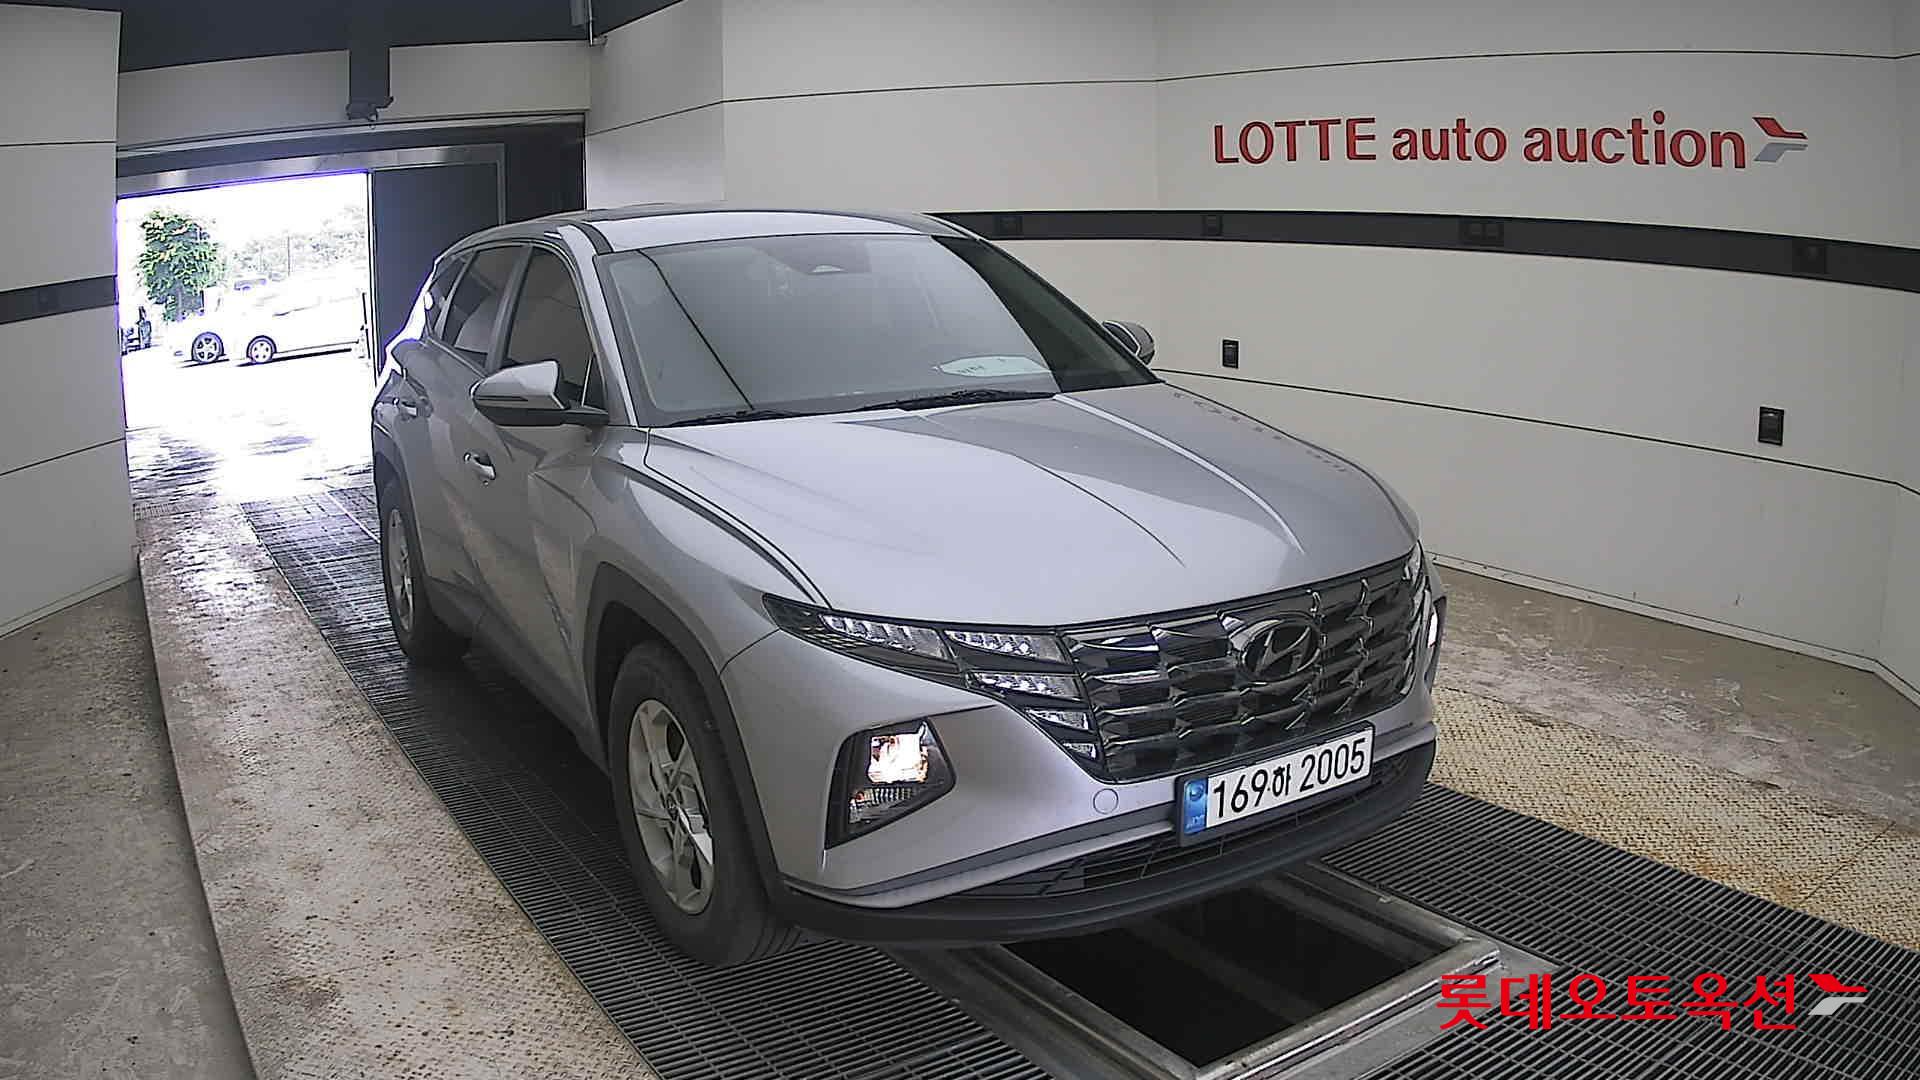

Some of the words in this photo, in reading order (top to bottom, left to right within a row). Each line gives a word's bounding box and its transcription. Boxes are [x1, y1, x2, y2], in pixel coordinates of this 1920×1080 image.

[1213, 117, 1377, 164] LOTTE
[1391, 117, 1508, 162] auto
[1522, 110, 1747, 169] auction
[1213, 763, 1292, 818] 169하
[1299, 737, 1367, 792] 2005
